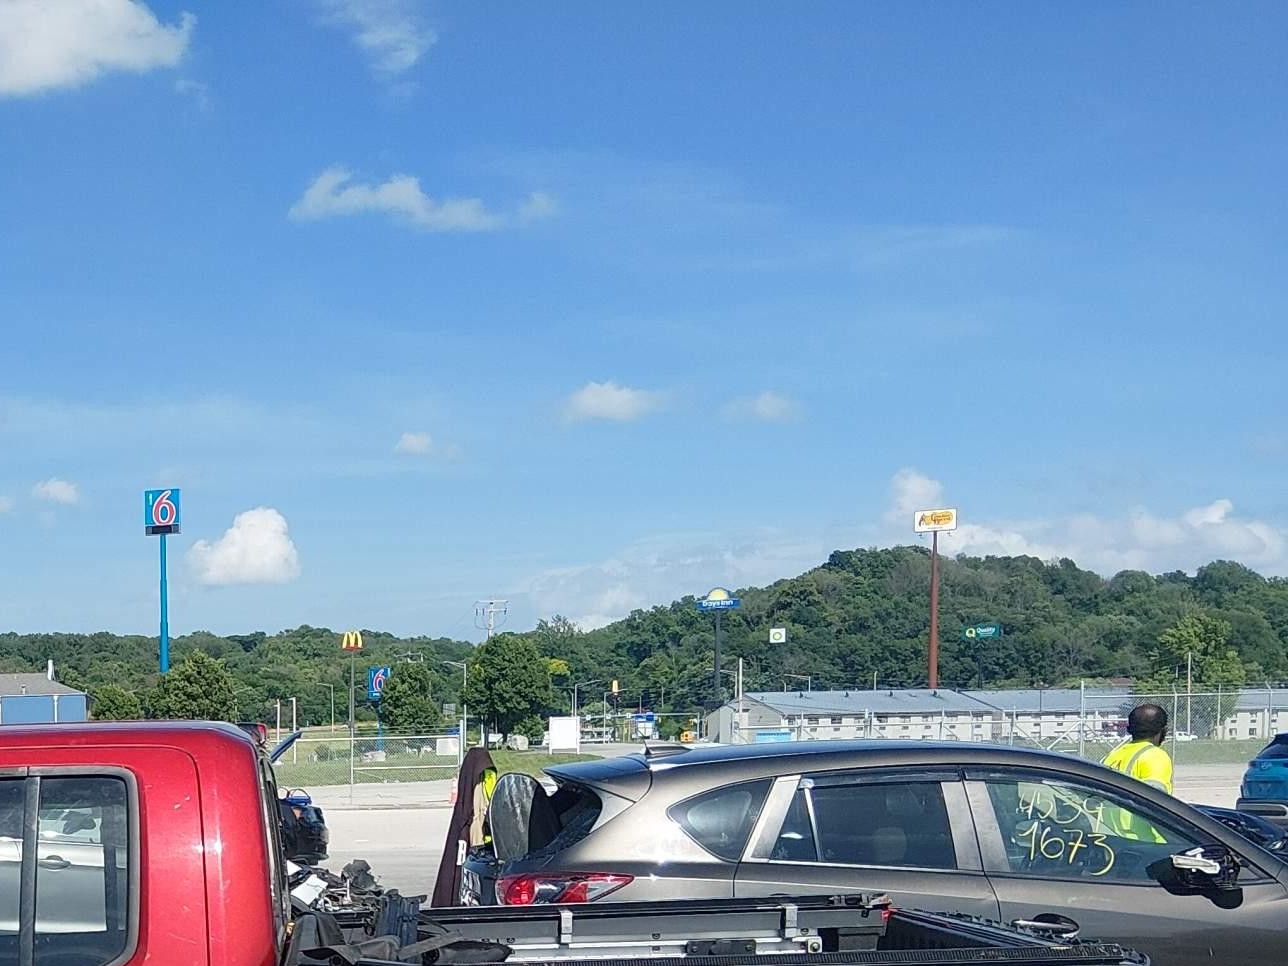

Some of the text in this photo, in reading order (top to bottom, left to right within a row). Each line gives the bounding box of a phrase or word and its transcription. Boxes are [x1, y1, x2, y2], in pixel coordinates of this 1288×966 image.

[152, 490, 176, 526] 6
[373, 668, 386, 692] 6
[1018, 821, 1114, 876] 1673
